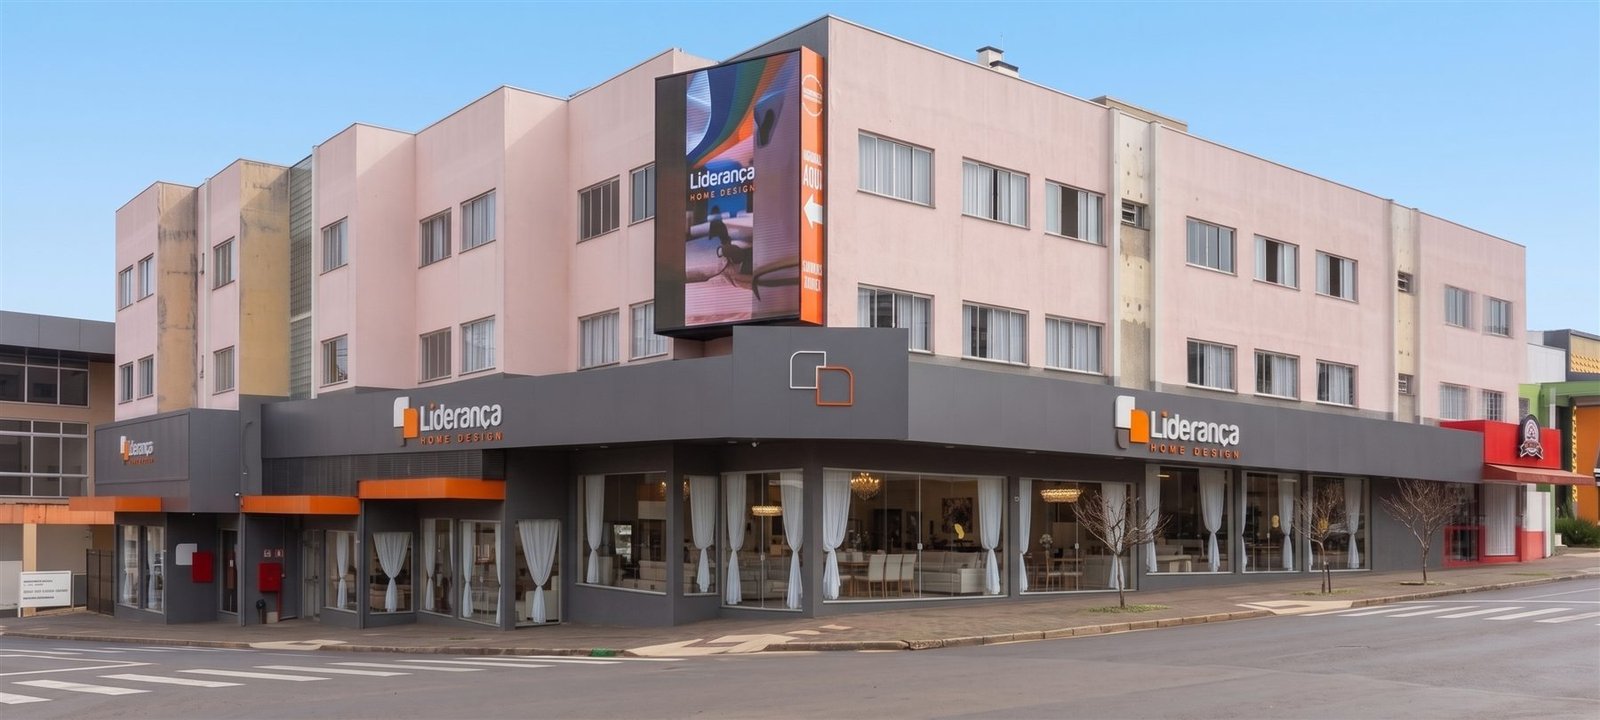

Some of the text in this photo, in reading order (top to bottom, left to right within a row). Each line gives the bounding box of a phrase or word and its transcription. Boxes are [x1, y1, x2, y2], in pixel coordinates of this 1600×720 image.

[690, 166, 755, 190] Liderança
[690, 184, 756, 201] HOME DESIGN
[420, 402, 502, 430] Liderança
[420, 432, 503, 445] HOME DESIGN
[1150, 410, 1240, 447] Liderança
[1150, 444, 1240, 459] HOME DESIGN
